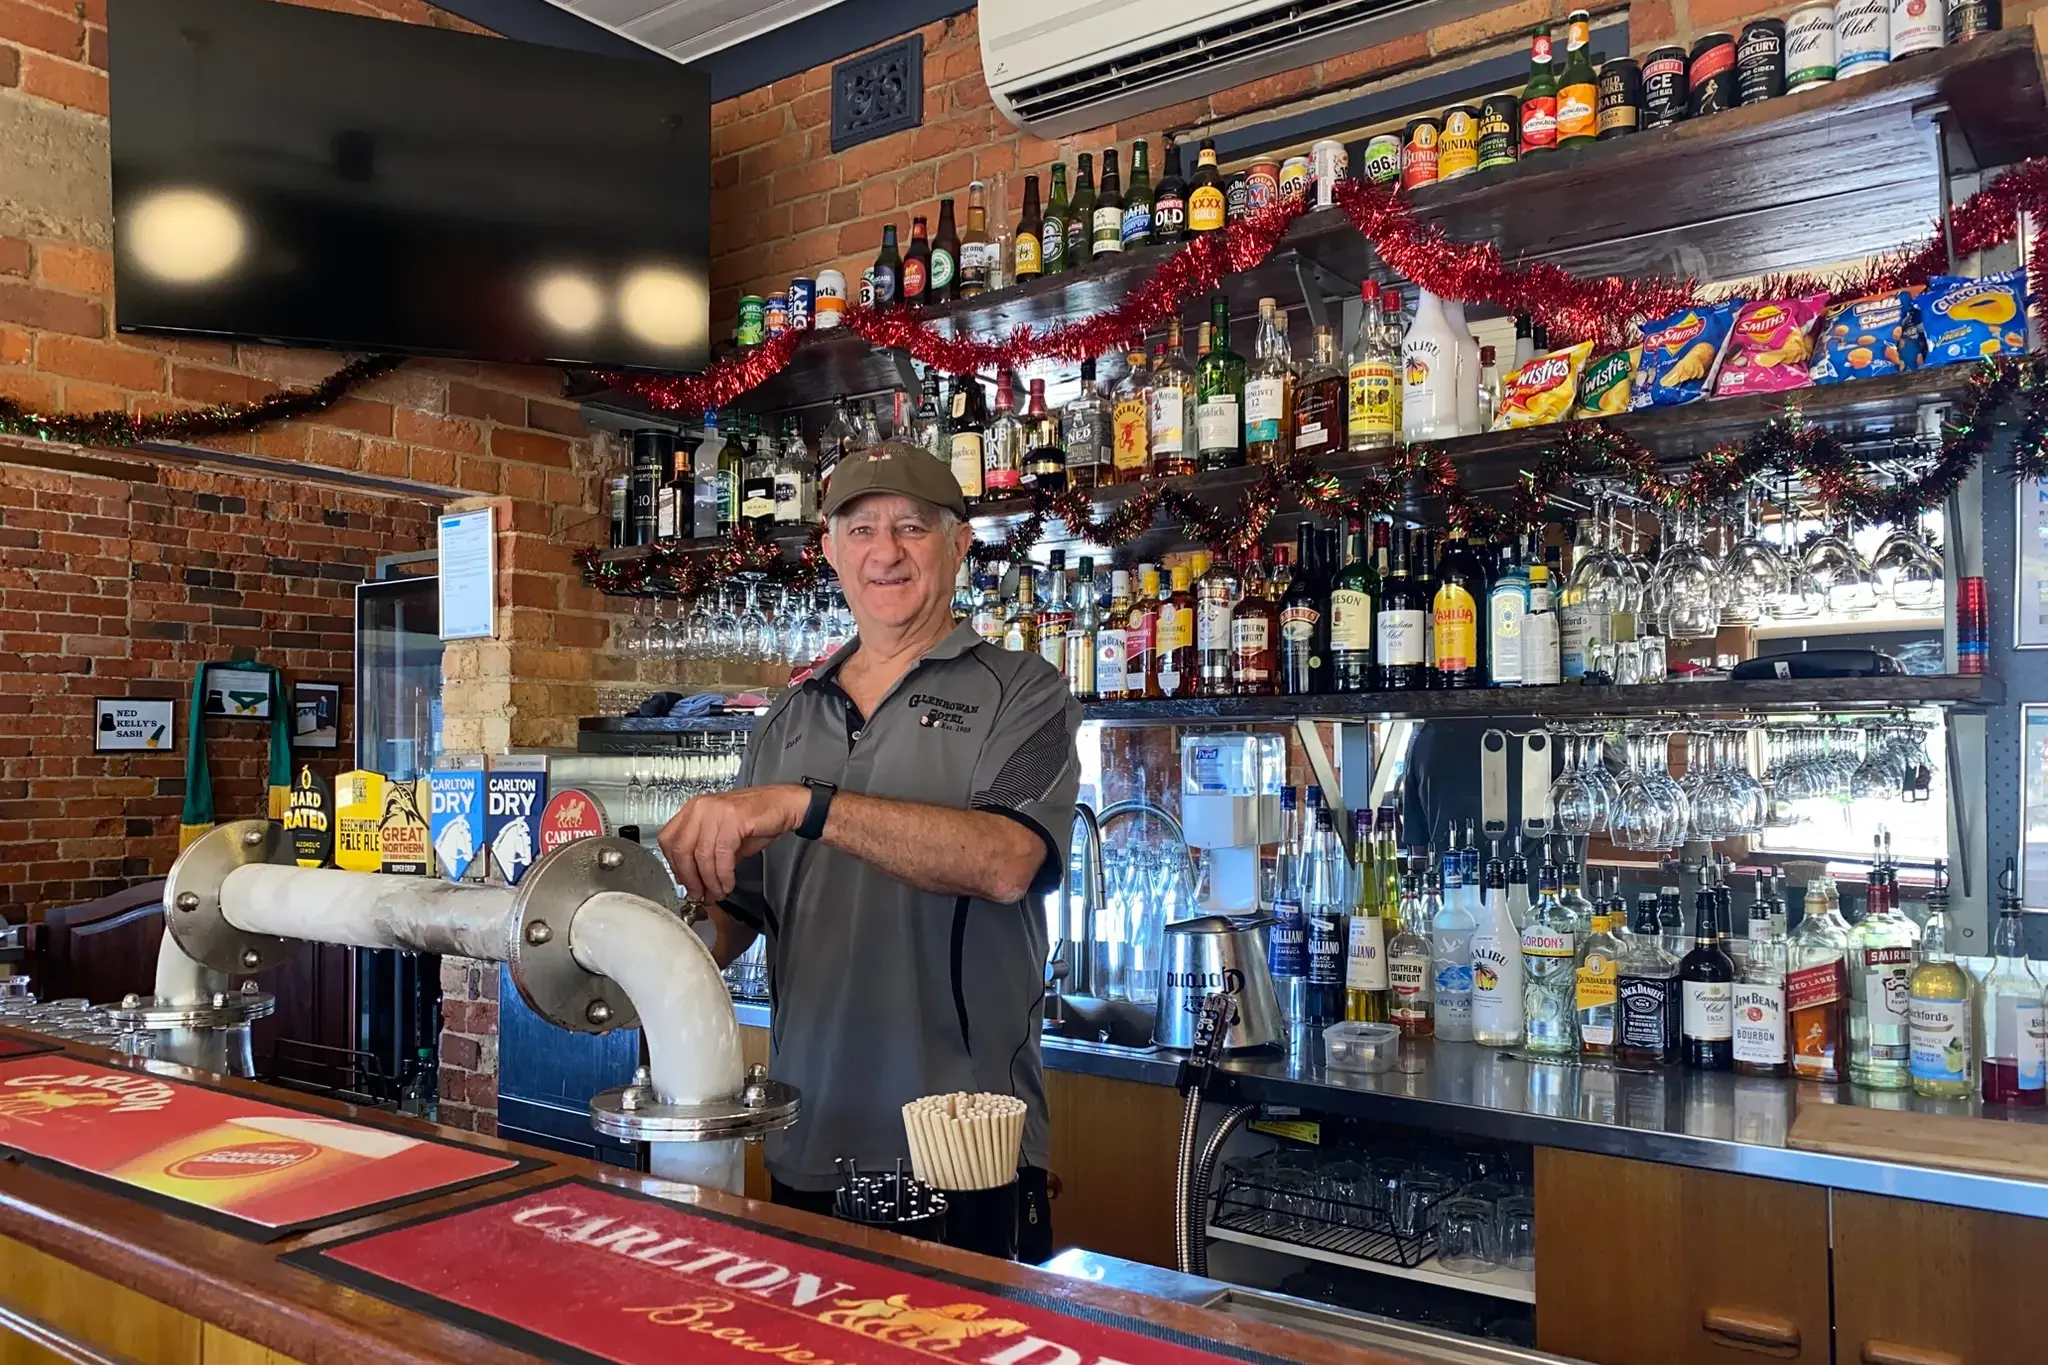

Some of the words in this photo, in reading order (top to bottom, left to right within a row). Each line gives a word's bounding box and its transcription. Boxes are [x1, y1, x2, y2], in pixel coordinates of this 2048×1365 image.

[1753, 65, 1775, 73] CIDER
[1646, 74, 1672, 93] ICE
[1123, 203, 1149, 222] HAHN
[1155, 200, 1184, 211] TOOHEYS
[1191, 199, 1221, 211] XXXX
[1155, 208, 1184, 227] OLD
[1114, 405, 1145, 422] FIREBALL
[1067, 428, 1091, 444] NED
[116, 709, 138, 717] NED
[116, 719, 158, 728] KELLY'S
[116, 729, 144, 738] SASH
[432, 778, 475, 791] CARLTON
[489, 778, 536, 791] CARLTON
[290, 791, 321, 808] HARD
[431, 792, 475, 814] DRY
[489, 792, 536, 816] DRY
[284, 807, 328, 832] RATED
[363, 832, 380, 851] ALE
[382, 826, 424, 842] GREAT
[382, 843, 424, 853] NORTHERN
[1521, 934, 1565, 949] GORDON'S
[1389, 963, 1423, 974] SOUTHERN
[1390, 973, 1421, 983] COMFORT
[1788, 981, 1807, 992] RED
[1809, 974, 1837, 987] LABEL
[1580, 988, 1613, 996] ORIGINAL
[1620, 985, 1637, 999] JACK
[1637, 983, 1665, 1002] DANIEL'S
[1734, 994, 1750, 1009] JIM
[1751, 992, 1779, 1013] BEAM
[1737, 1029, 1775, 1041] BOURBON
[4, 1074, 176, 1113] CARLTON
[512, 1203, 857, 1308] CARLTON
